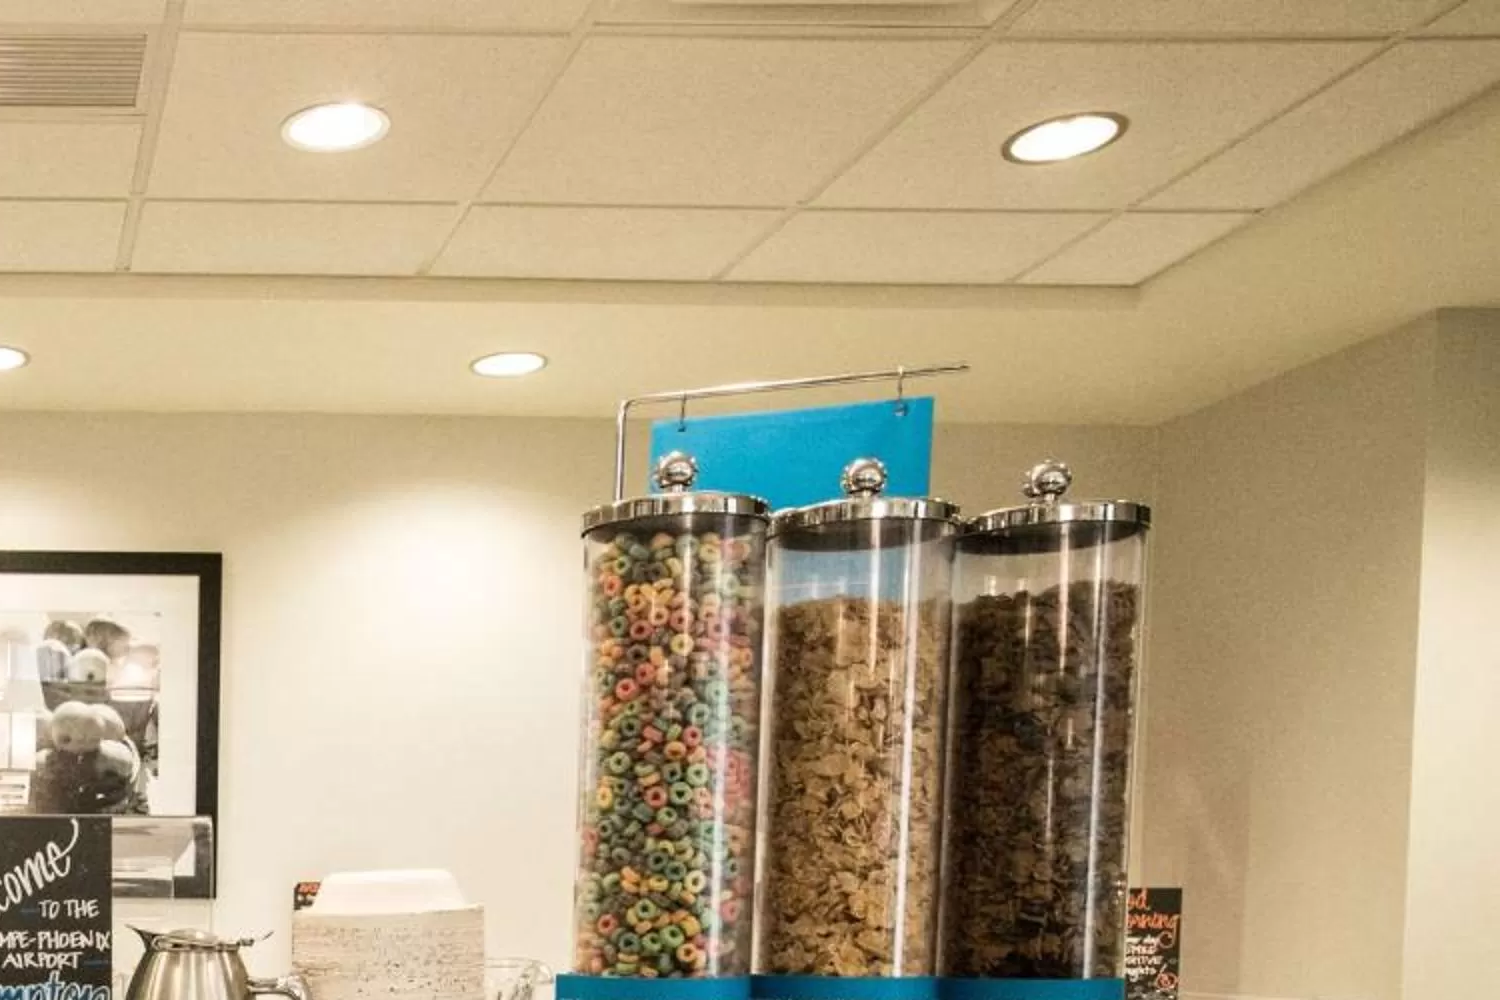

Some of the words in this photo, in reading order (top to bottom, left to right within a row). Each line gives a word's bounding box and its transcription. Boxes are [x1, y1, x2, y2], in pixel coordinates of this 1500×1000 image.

[38, 900, 59, 918] TO
[65, 899, 100, 918] THE
[1, 952, 83, 969] AIRPORT
